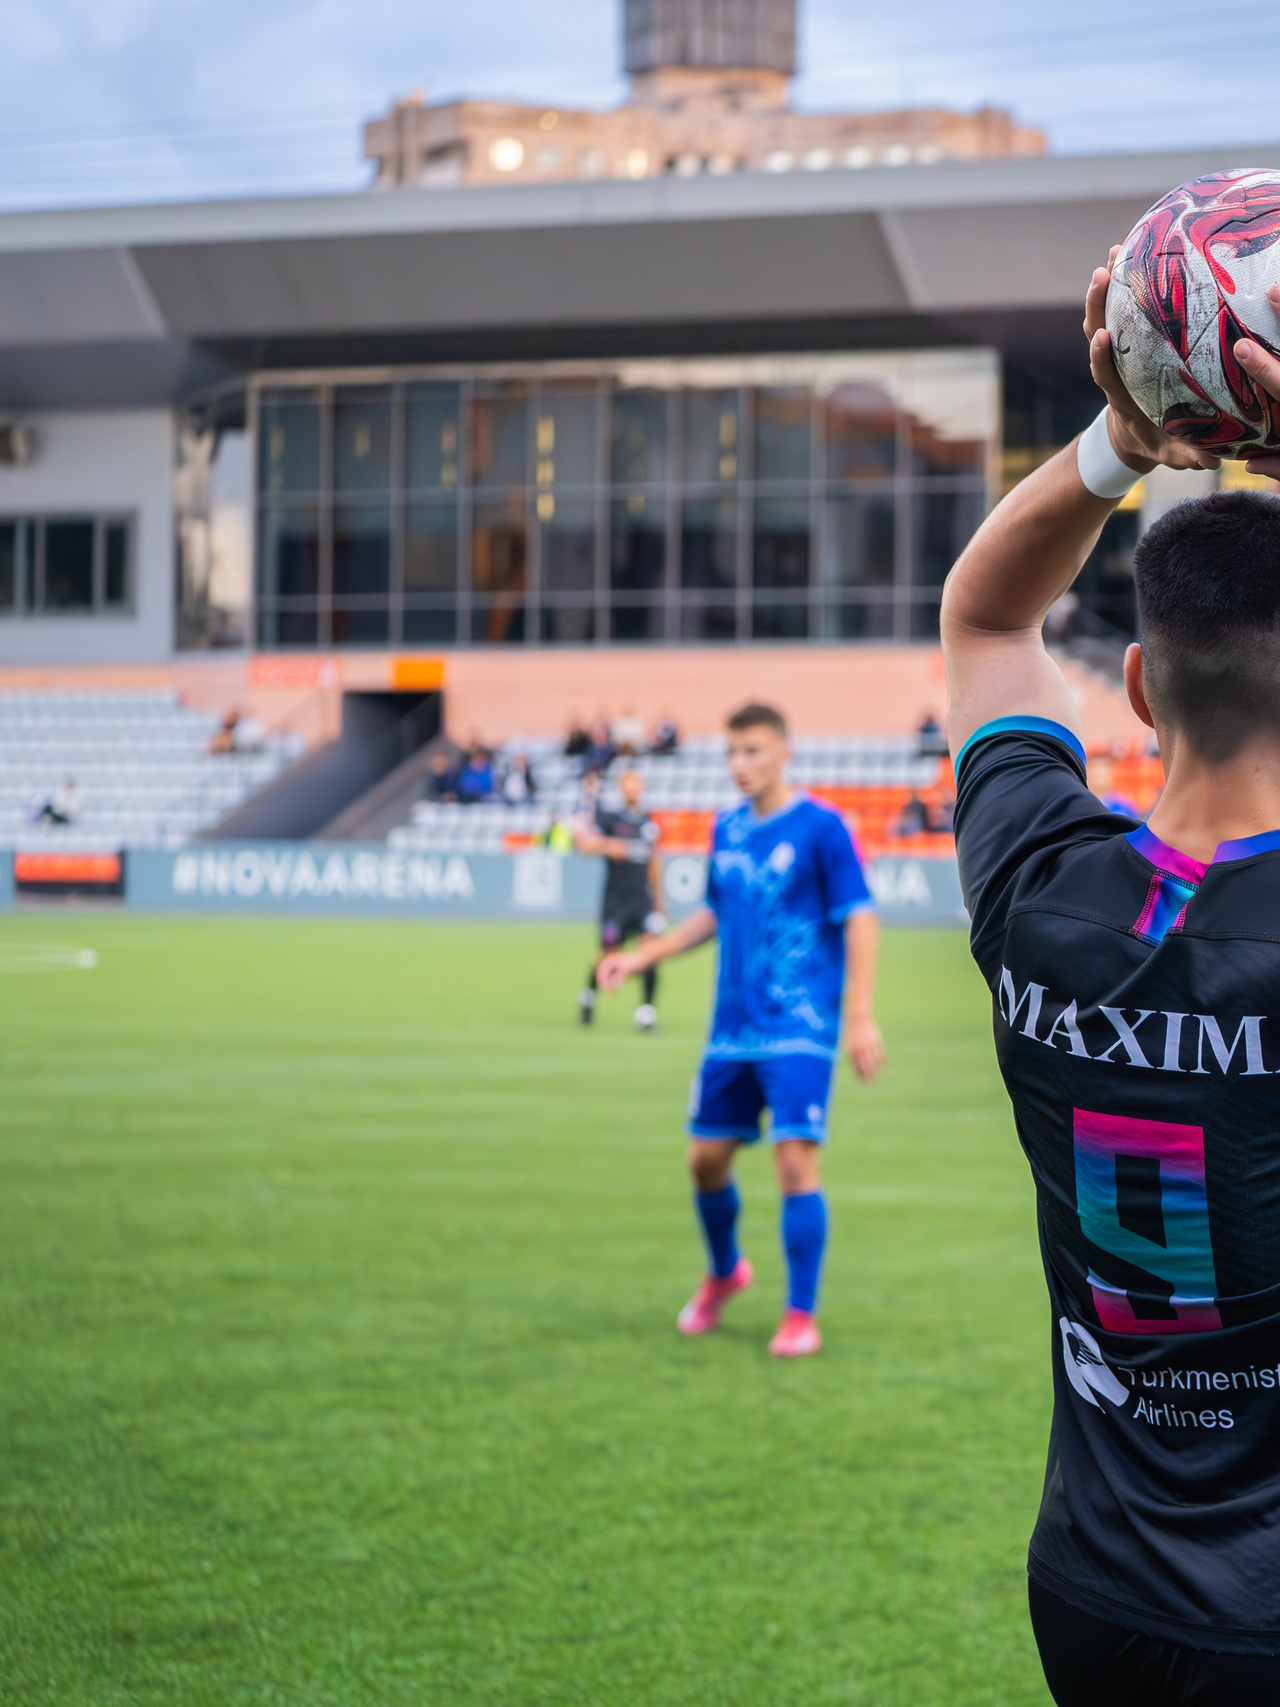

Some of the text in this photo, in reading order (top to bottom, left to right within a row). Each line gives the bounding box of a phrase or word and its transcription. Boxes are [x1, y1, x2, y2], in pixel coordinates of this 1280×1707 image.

[172, 849, 476, 899] #NOVAARENA
[1072, 1106, 1224, 1336] 9
[1132, 1396, 1235, 1430] Airlines
